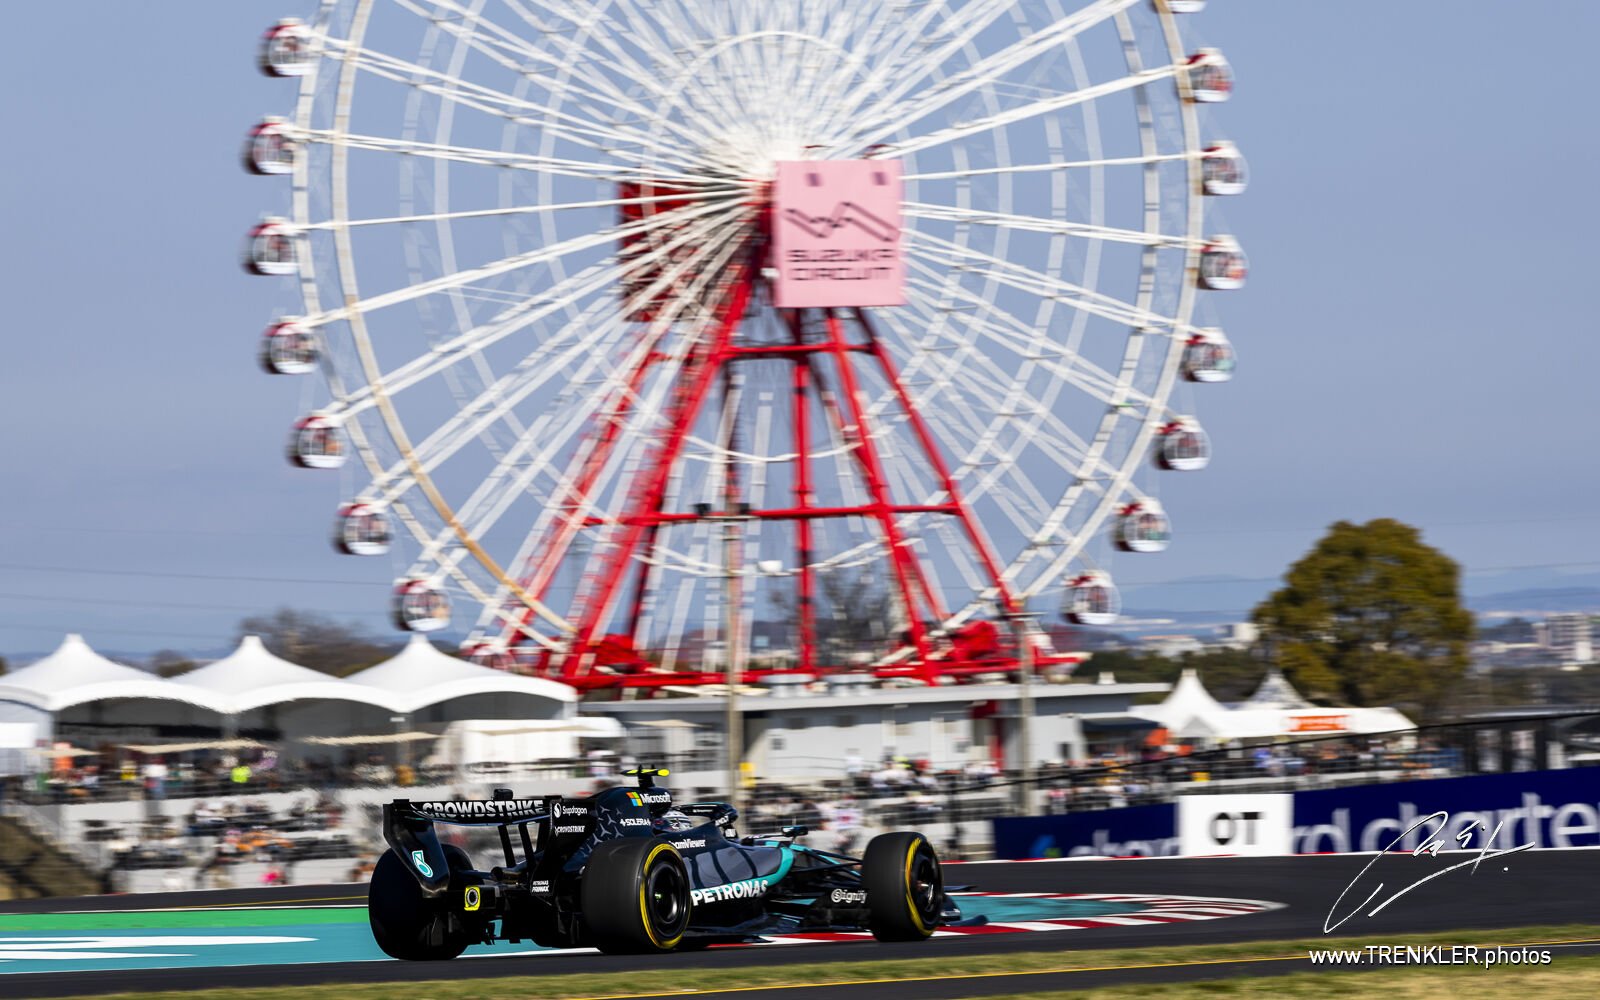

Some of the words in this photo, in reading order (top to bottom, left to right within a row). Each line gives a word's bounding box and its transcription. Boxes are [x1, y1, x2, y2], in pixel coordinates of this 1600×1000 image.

[640, 792, 672, 804] Microsoft
[422, 800, 545, 817] CROWDSTRIKE
[562, 805, 588, 816] Snapdragon
[1360, 792, 1600, 854] charte
[690, 880, 769, 906] PETRONAS
